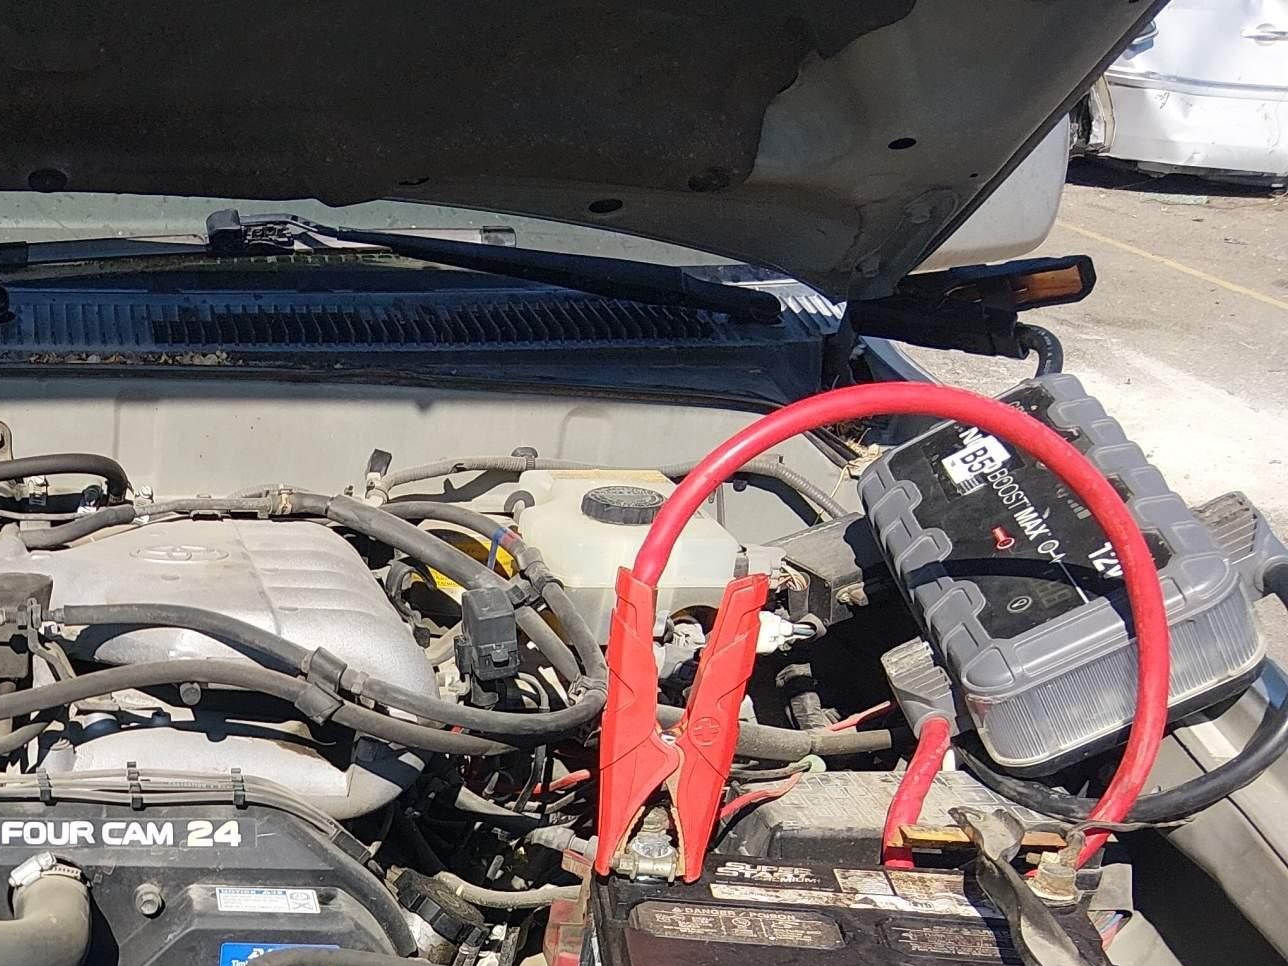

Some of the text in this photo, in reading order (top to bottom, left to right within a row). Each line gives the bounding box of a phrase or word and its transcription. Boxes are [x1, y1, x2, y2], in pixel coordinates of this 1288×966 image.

[987, 468, 1029, 510] BOOST
[1013, 507, 1050, 541] MAX
[1, 820, 96, 846] FOUR
[102, 820, 174, 846] CAM
[187, 820, 242, 847] 24
[684, 907, 736, 917] DANGER
